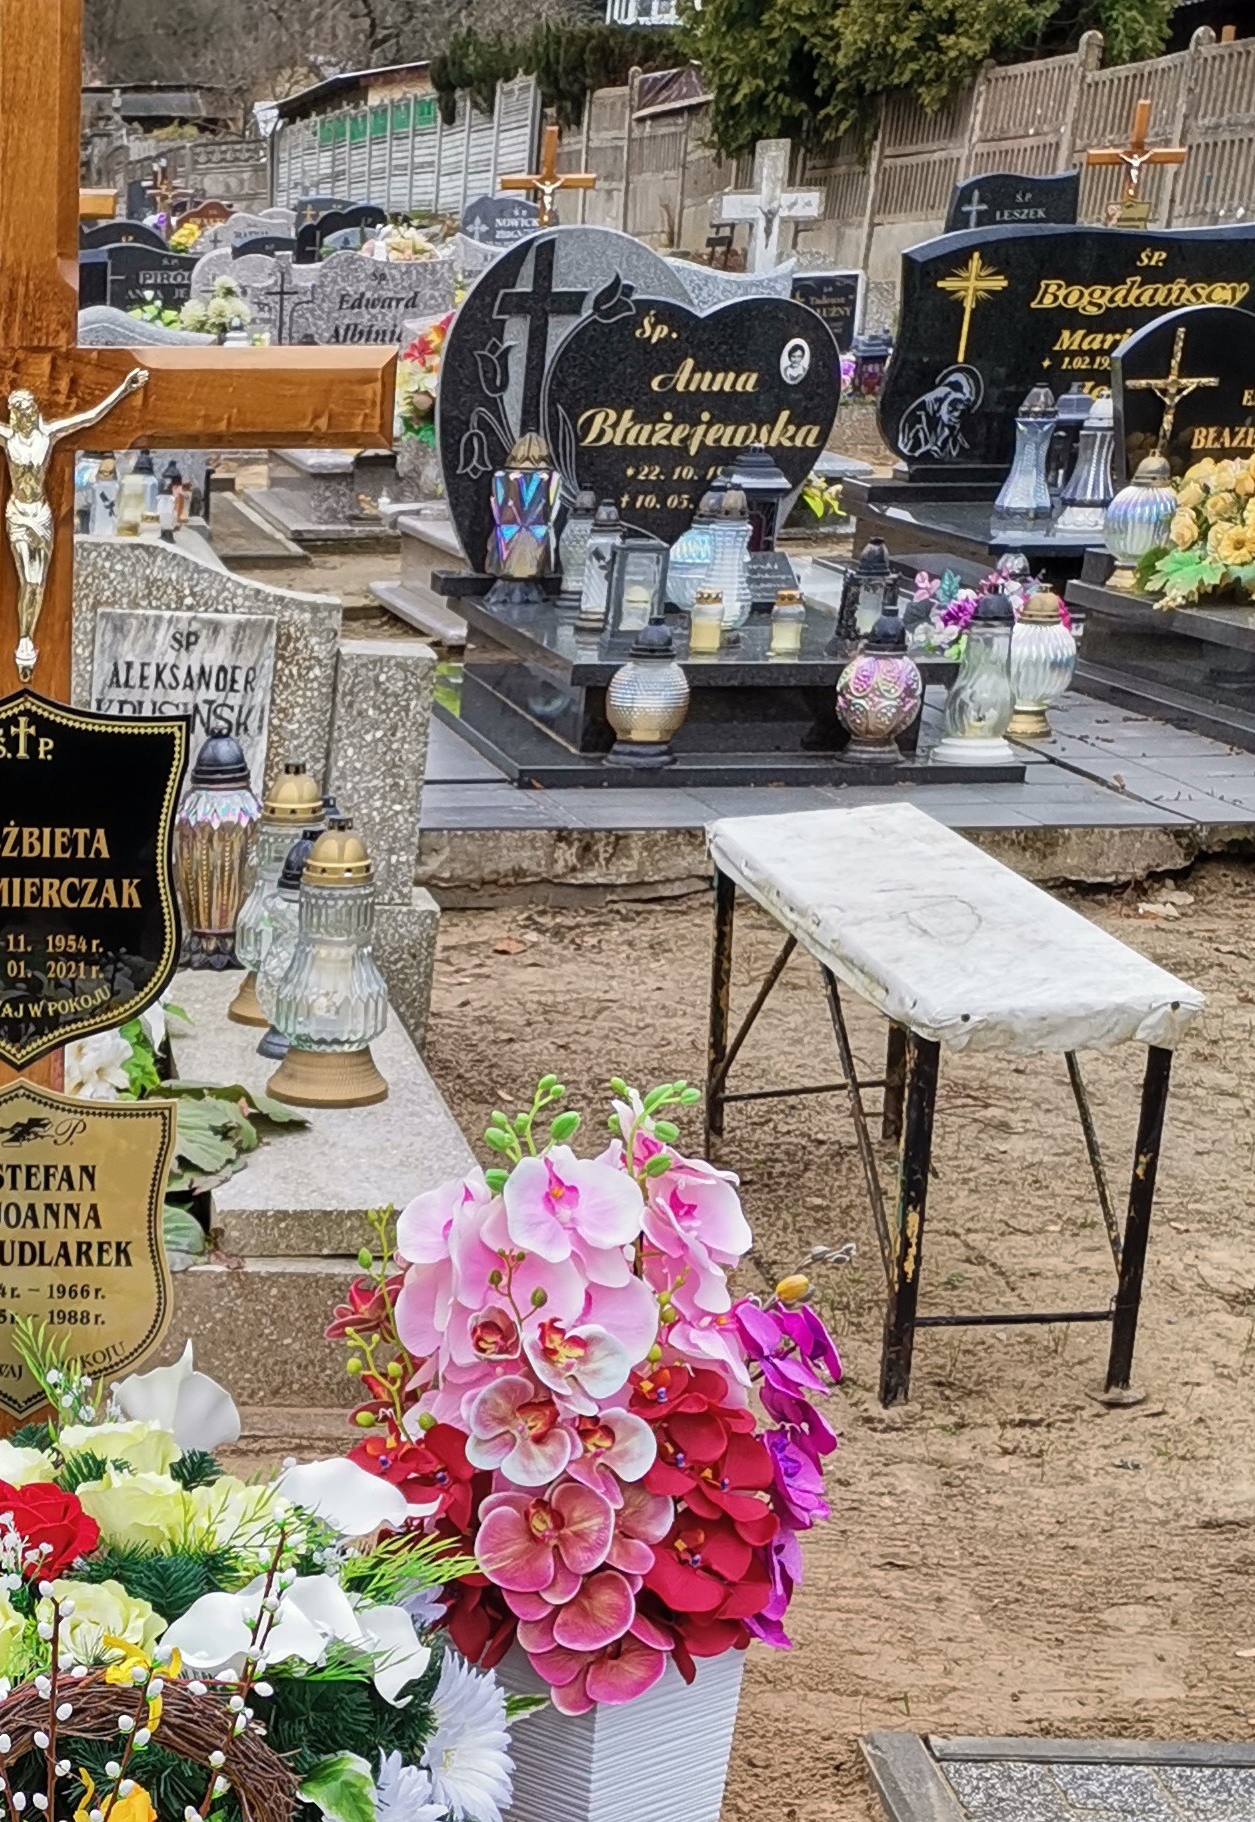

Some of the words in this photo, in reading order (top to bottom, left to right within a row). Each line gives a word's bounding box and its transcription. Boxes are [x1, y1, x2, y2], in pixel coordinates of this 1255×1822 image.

[995, 207, 1047, 221] LESZEK
[141, 269, 192, 284] PIRÓ
[337, 290, 420, 311] Edward
[1030, 276, 1249, 316] Bogdańscy
[635, 310, 680, 343] Śp.
[651, 357, 760, 394] Anna
[577, 407, 822, 458] Błażejewska
[672, 465, 699, 480] 10.
[635, 494, 661, 509] 10.
[667, 494, 695, 509] 05.
[108, 660, 257, 693] ALEKSANDER
[6, 933, 33, 953] 11.
[6, 959, 33, 978] 01.
[27, 1000, 47, 1019] W
[47, 985, 113, 1017] POKOJU
